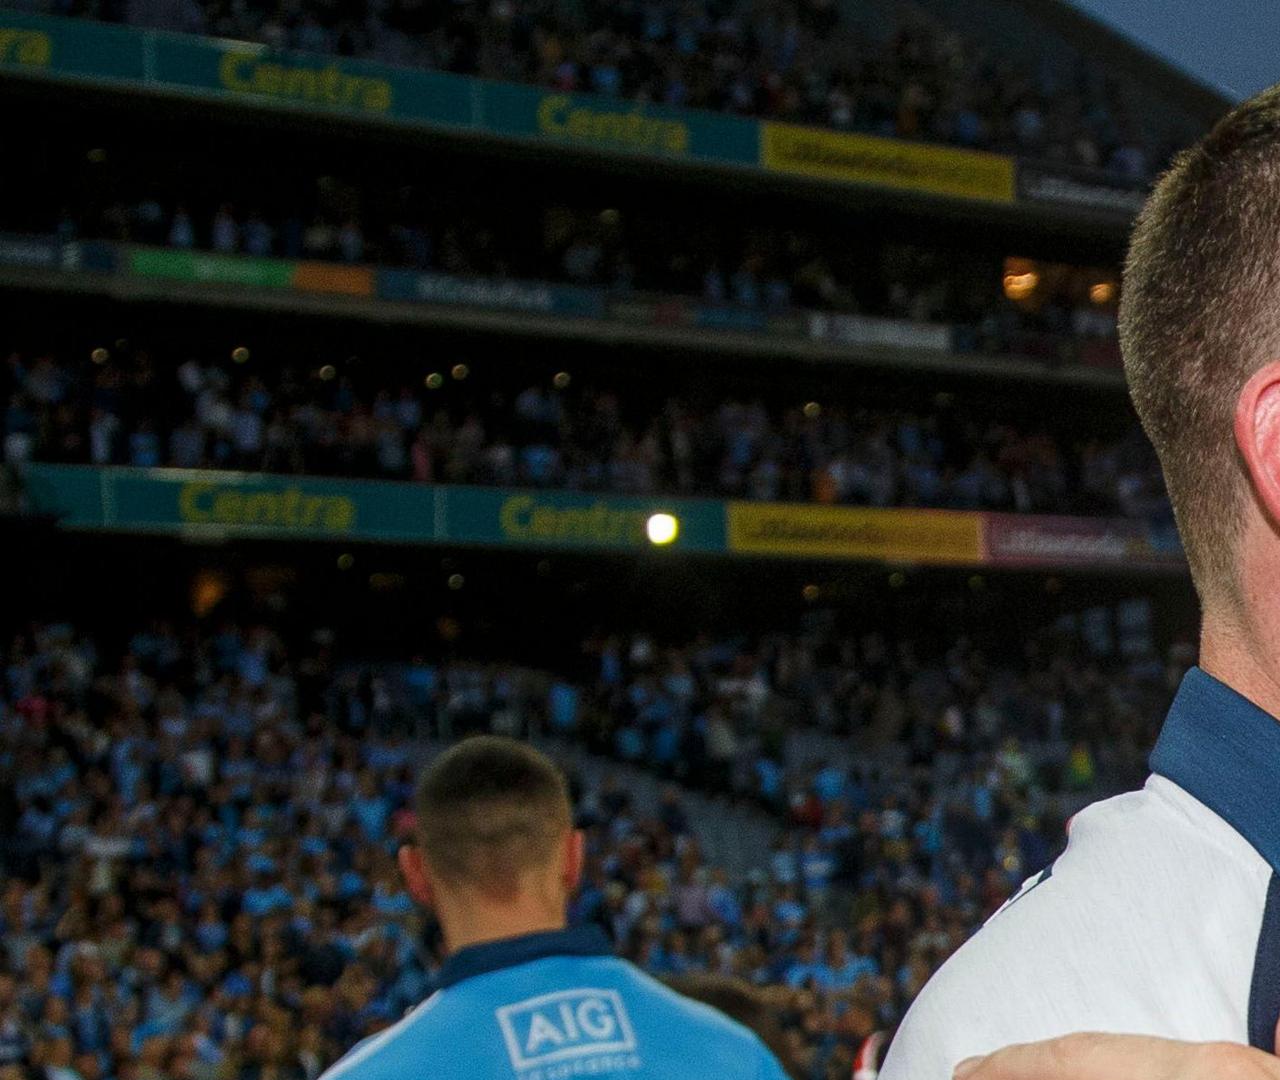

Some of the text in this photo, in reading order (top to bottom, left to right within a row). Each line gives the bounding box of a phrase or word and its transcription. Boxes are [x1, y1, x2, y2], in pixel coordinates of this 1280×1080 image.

[219, 51, 392, 113] Centra
[537, 96, 690, 153] Centra
[179, 481, 356, 532] Centra
[501, 496, 650, 541] Centr
[525, 998, 617, 1053] AIG
